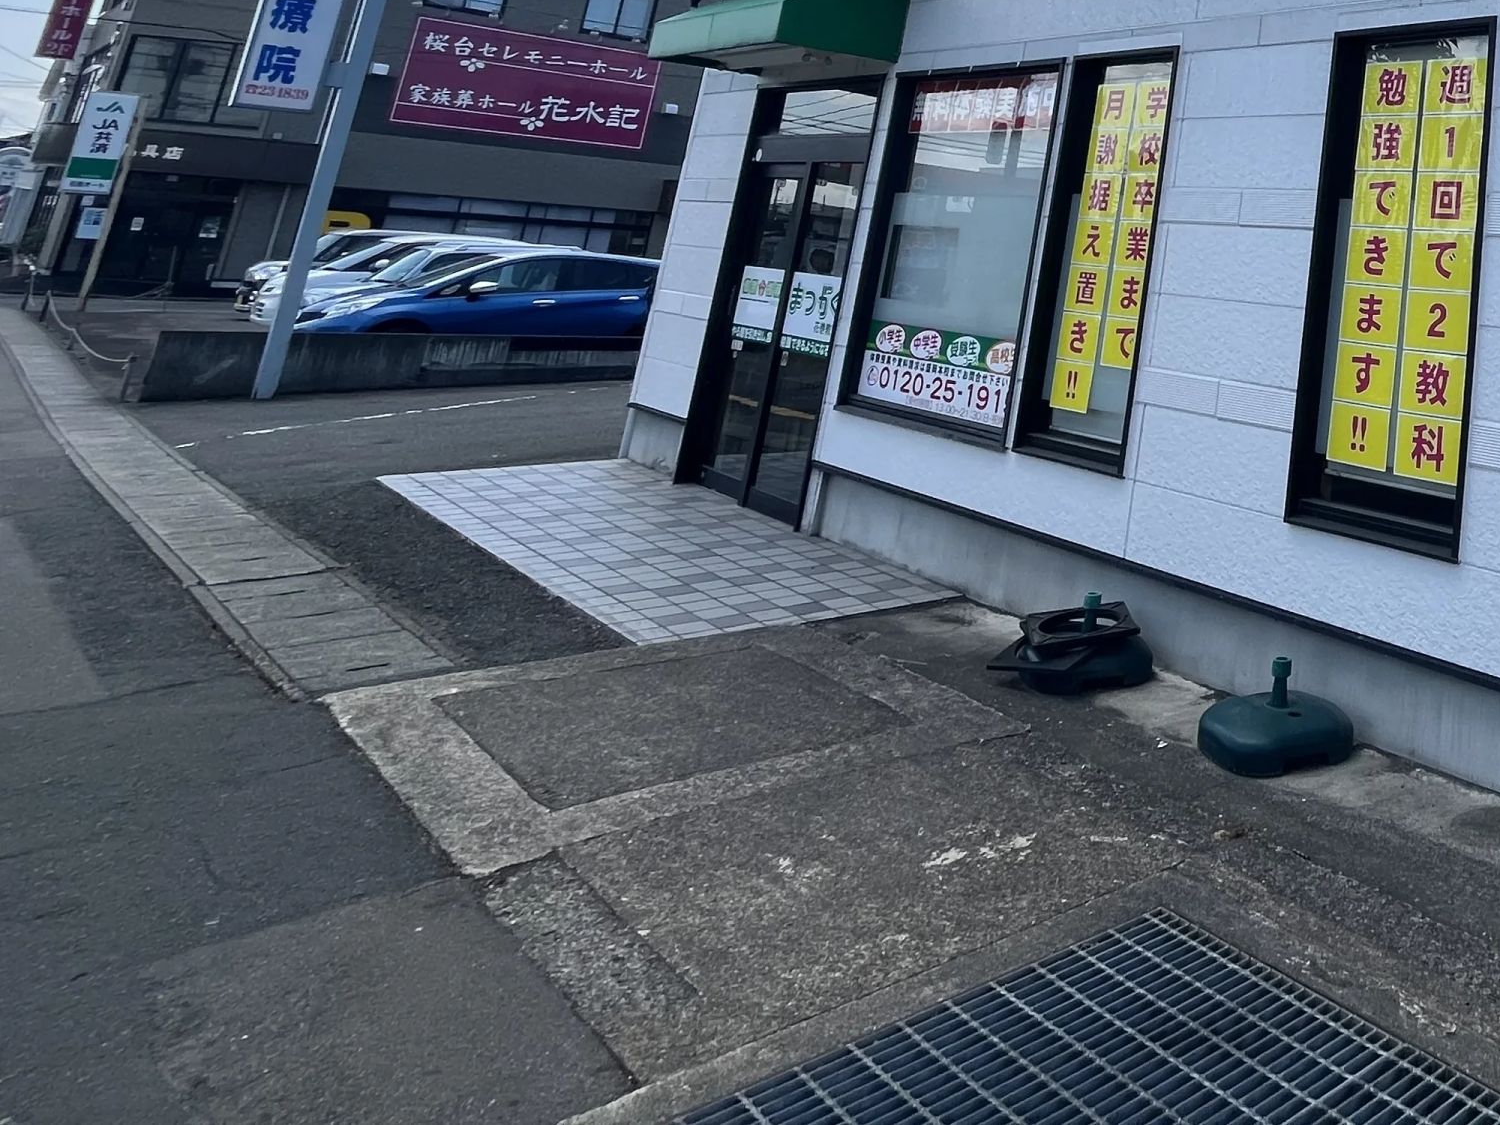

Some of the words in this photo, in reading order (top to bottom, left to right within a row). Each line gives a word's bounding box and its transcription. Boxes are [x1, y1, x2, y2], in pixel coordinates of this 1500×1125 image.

[423, 31, 648, 81] 桜台セレモニーホール
[408, 82, 536, 114] 家族葬ホール
[538, 95, 641, 131] 花水記
[132, 144, 185, 161] 具店
[1115, 86, 1168, 359] 学校卒業まで
[1410, 65, 1472, 473] 週1回で2教科
[879, 365, 1007, 415] 0120-25-191
